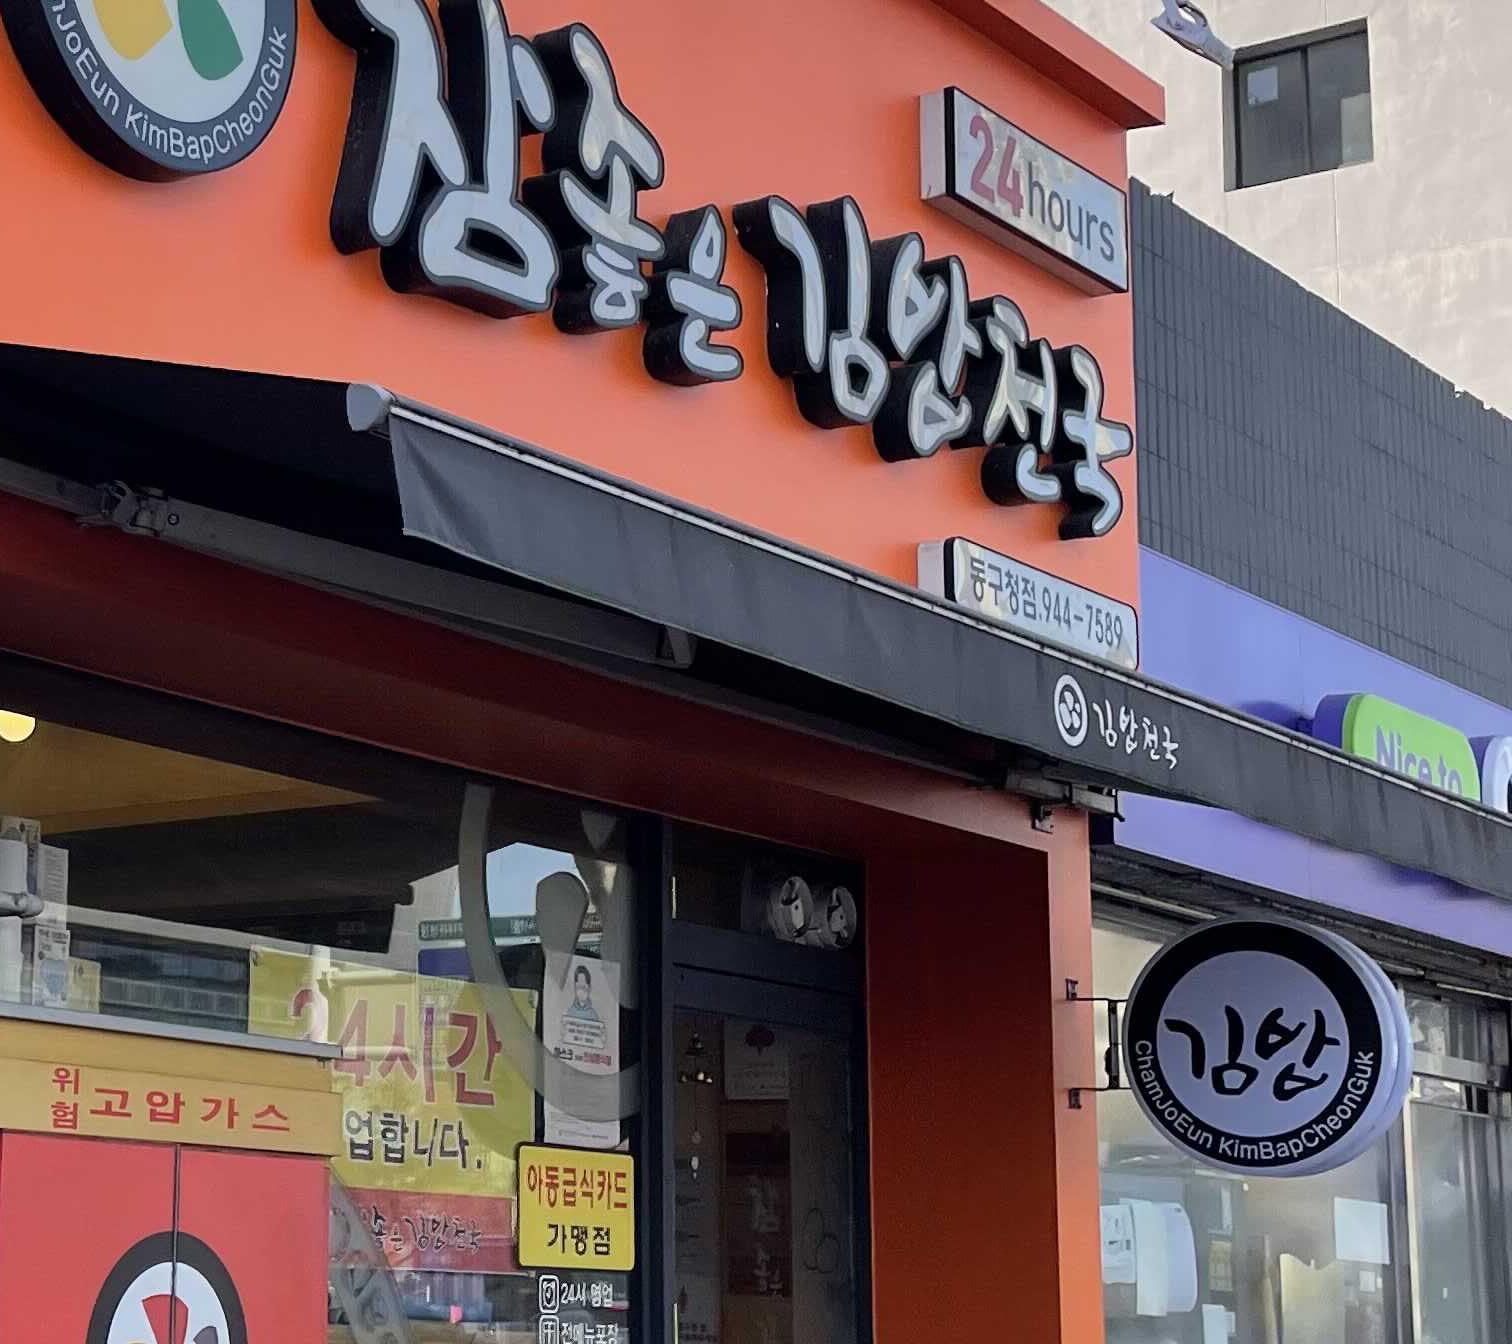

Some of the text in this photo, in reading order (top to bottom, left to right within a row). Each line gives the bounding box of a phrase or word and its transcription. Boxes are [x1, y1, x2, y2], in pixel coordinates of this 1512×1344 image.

[124, 26, 289, 164] KimBapCheonGuk
[756, 195, 1133, 536] 김밥천국
[1092, 698, 1180, 770] 김밥천국
[1163, 1005, 1341, 1102] 김밥
[88, 1087, 291, 1132] 고압가스
[1135, 1040, 1376, 1160] ChamJoEun KimBapCheonGuk
[526, 1164, 628, 1210] 아동급식카드
[546, 1223, 611, 1256] 가맹점
